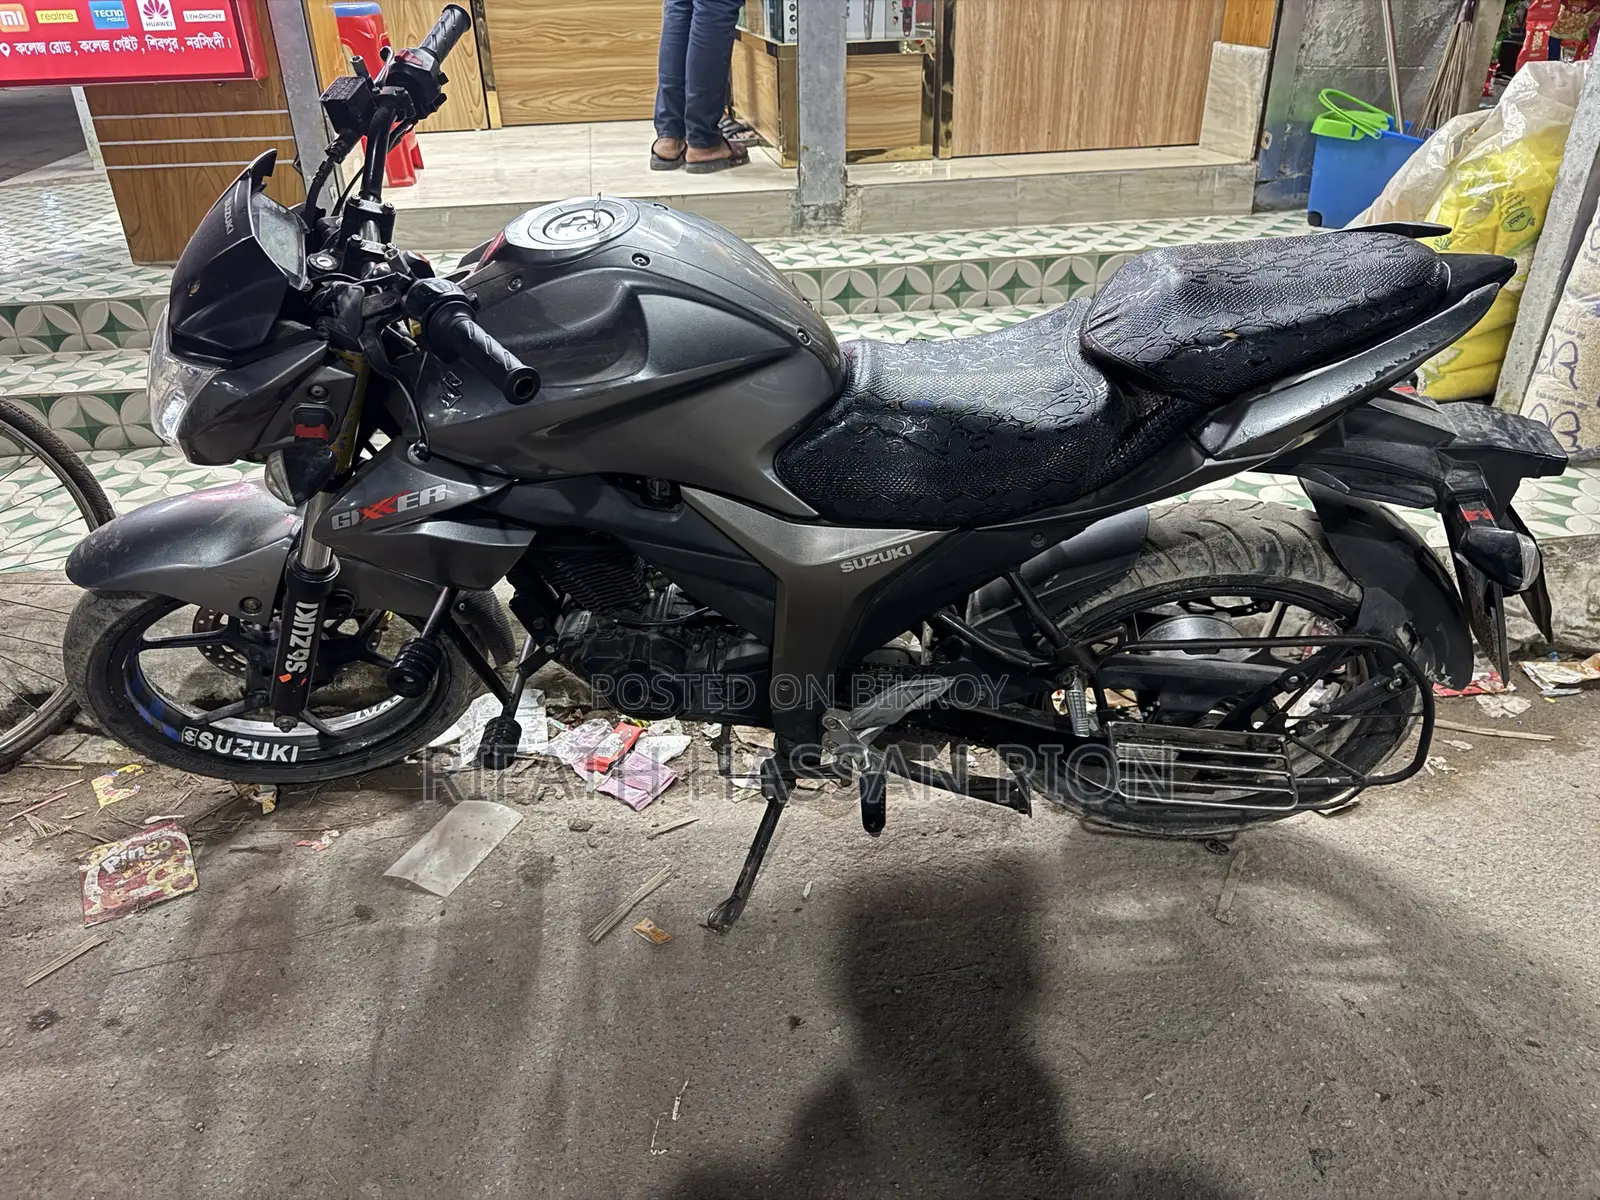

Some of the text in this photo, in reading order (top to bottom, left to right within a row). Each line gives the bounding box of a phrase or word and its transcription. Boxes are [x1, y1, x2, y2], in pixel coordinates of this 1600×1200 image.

[40, 13, 74, 21] realme
[13, 41, 47, 56] কলেজ
[77, 39, 111, 53] কলেজ
[331, 483, 448, 531] GIXXER
[840, 543, 913, 573] SUZUKI
[197, 730, 300, 764] SUZUKI
